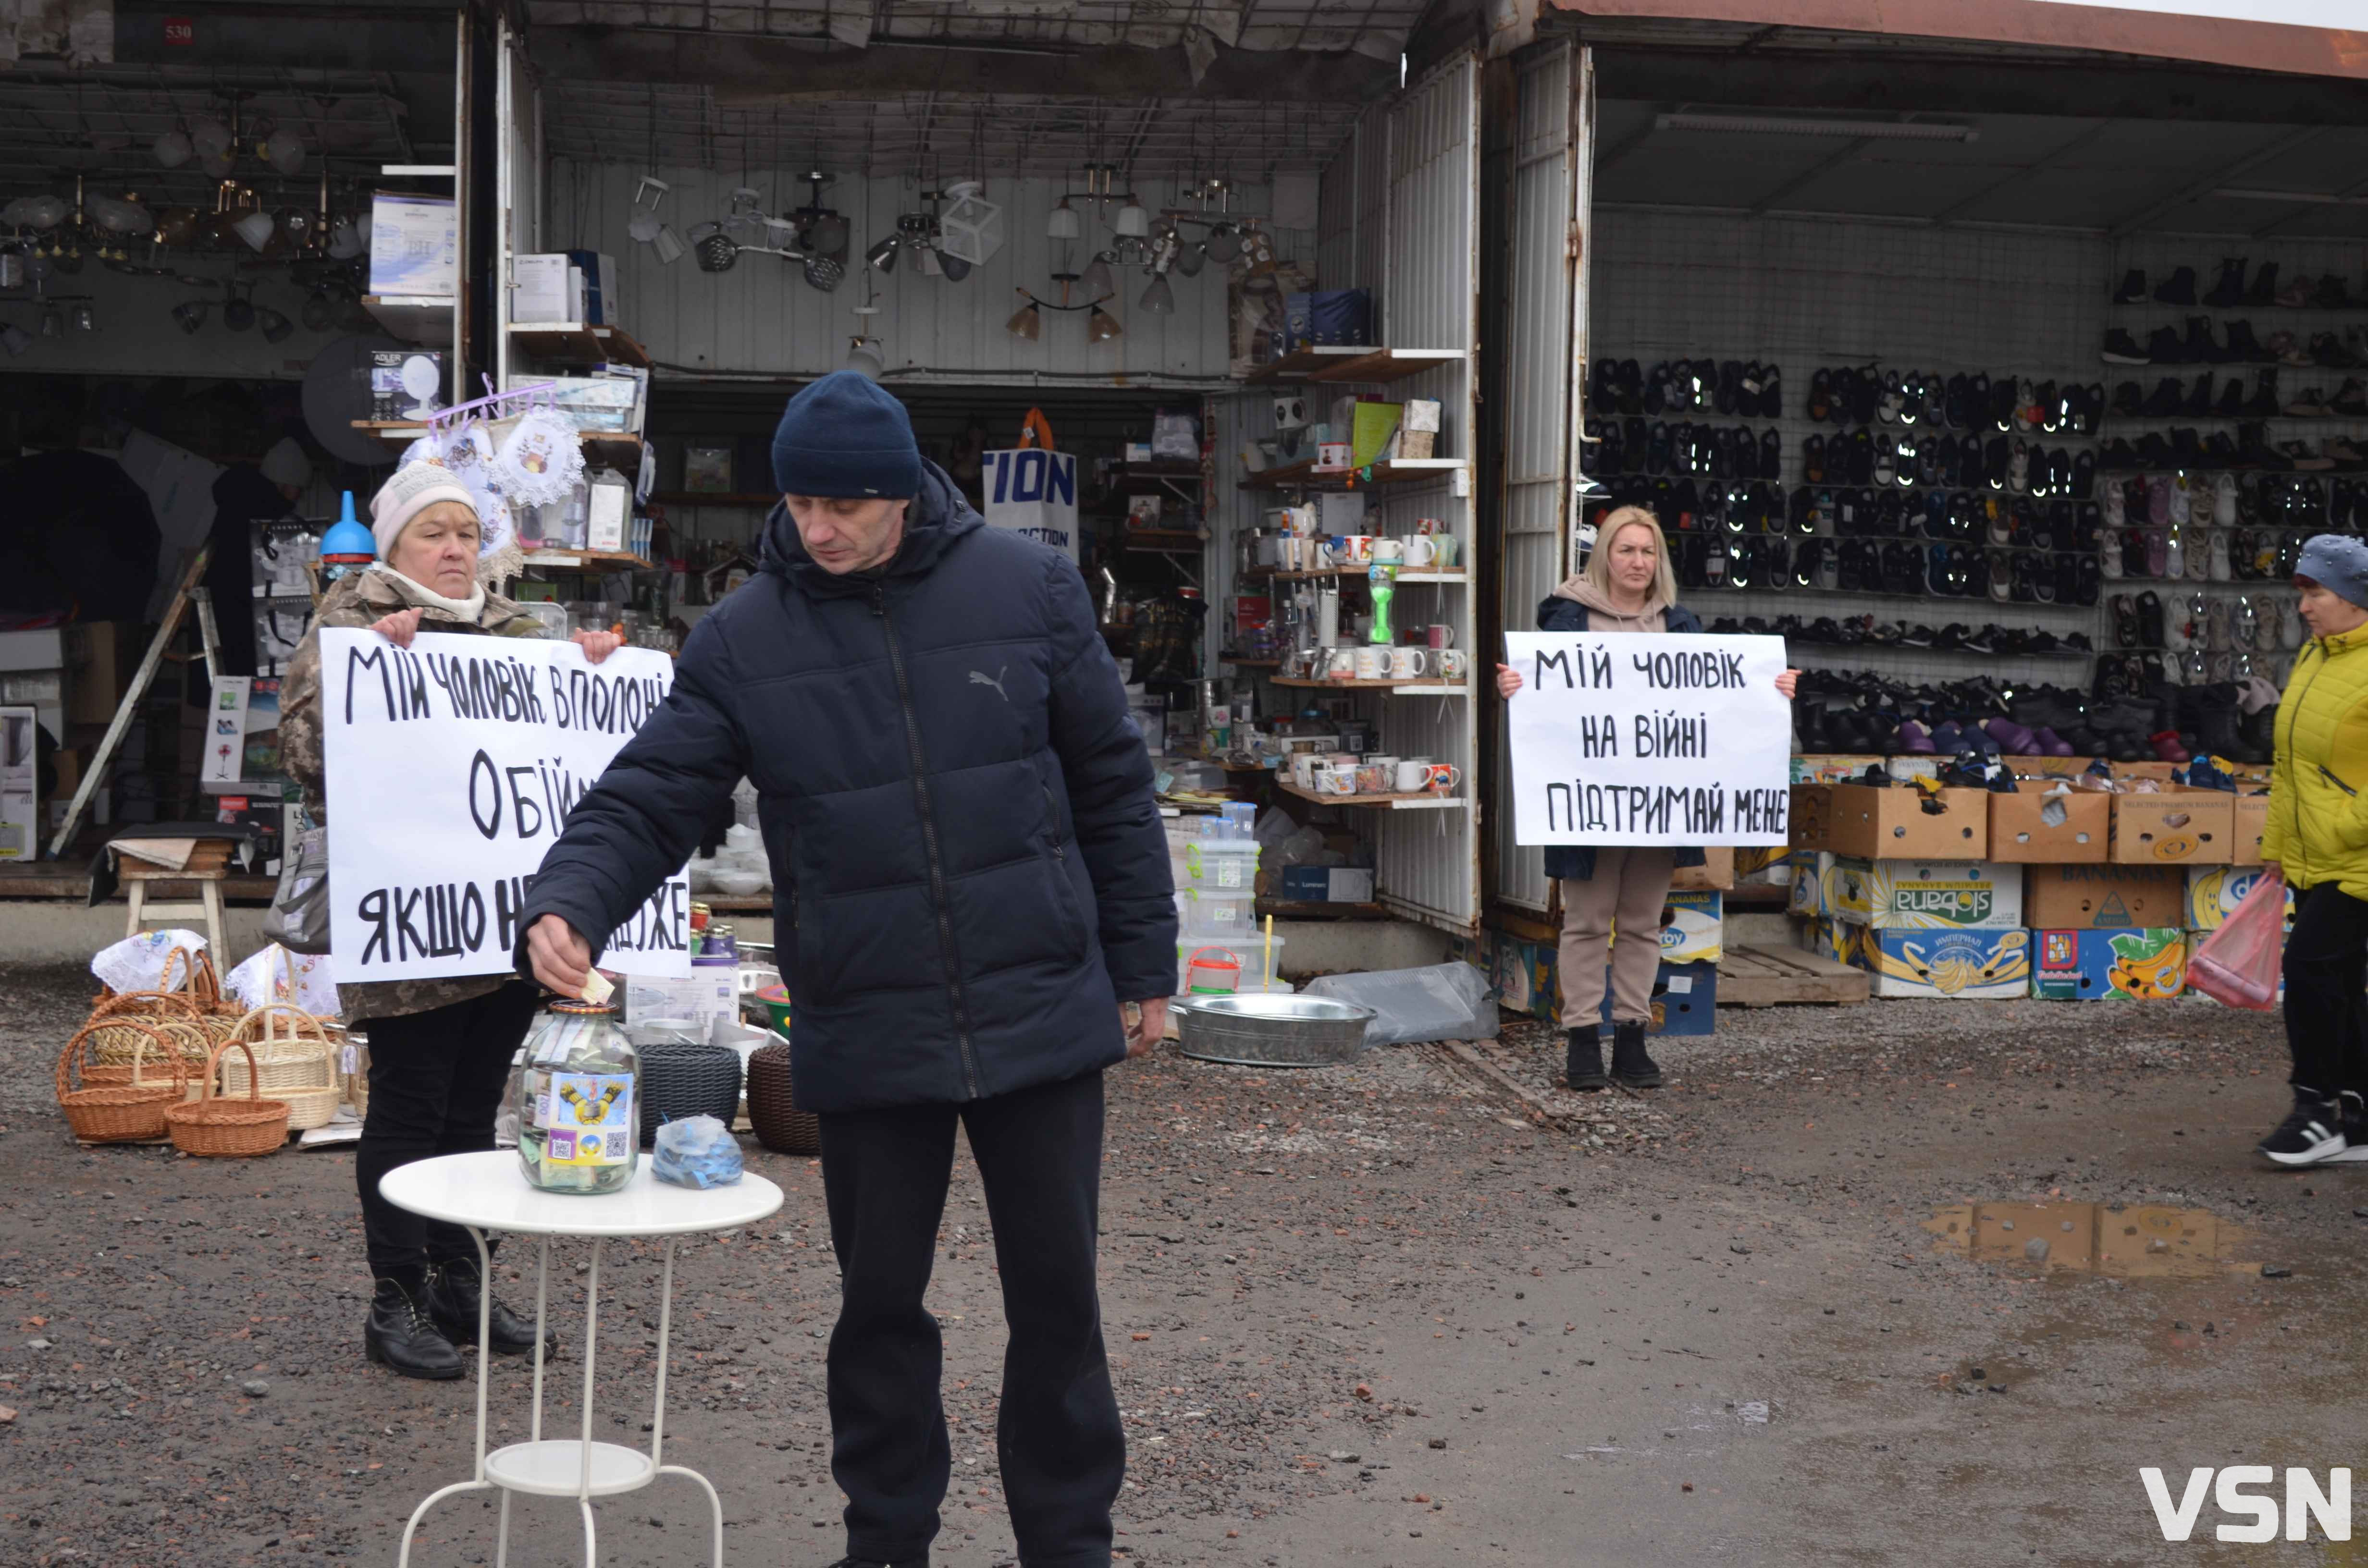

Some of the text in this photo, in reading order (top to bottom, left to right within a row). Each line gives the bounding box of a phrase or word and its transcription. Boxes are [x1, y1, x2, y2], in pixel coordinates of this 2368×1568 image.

[166, 25, 192, 38] 530
[427, 651, 547, 724] ЧОЛОВІК
[1536, 643, 1747, 690] МІЙ ЧОЛОВІК
[1581, 710, 1707, 758] НА ВІЙНІ
[1547, 779, 1788, 834] ПІДТРИМАЙ МЕНЕ
[358, 882, 486, 965] ЯКЩО
[1898, 891, 1990, 918] slobana
